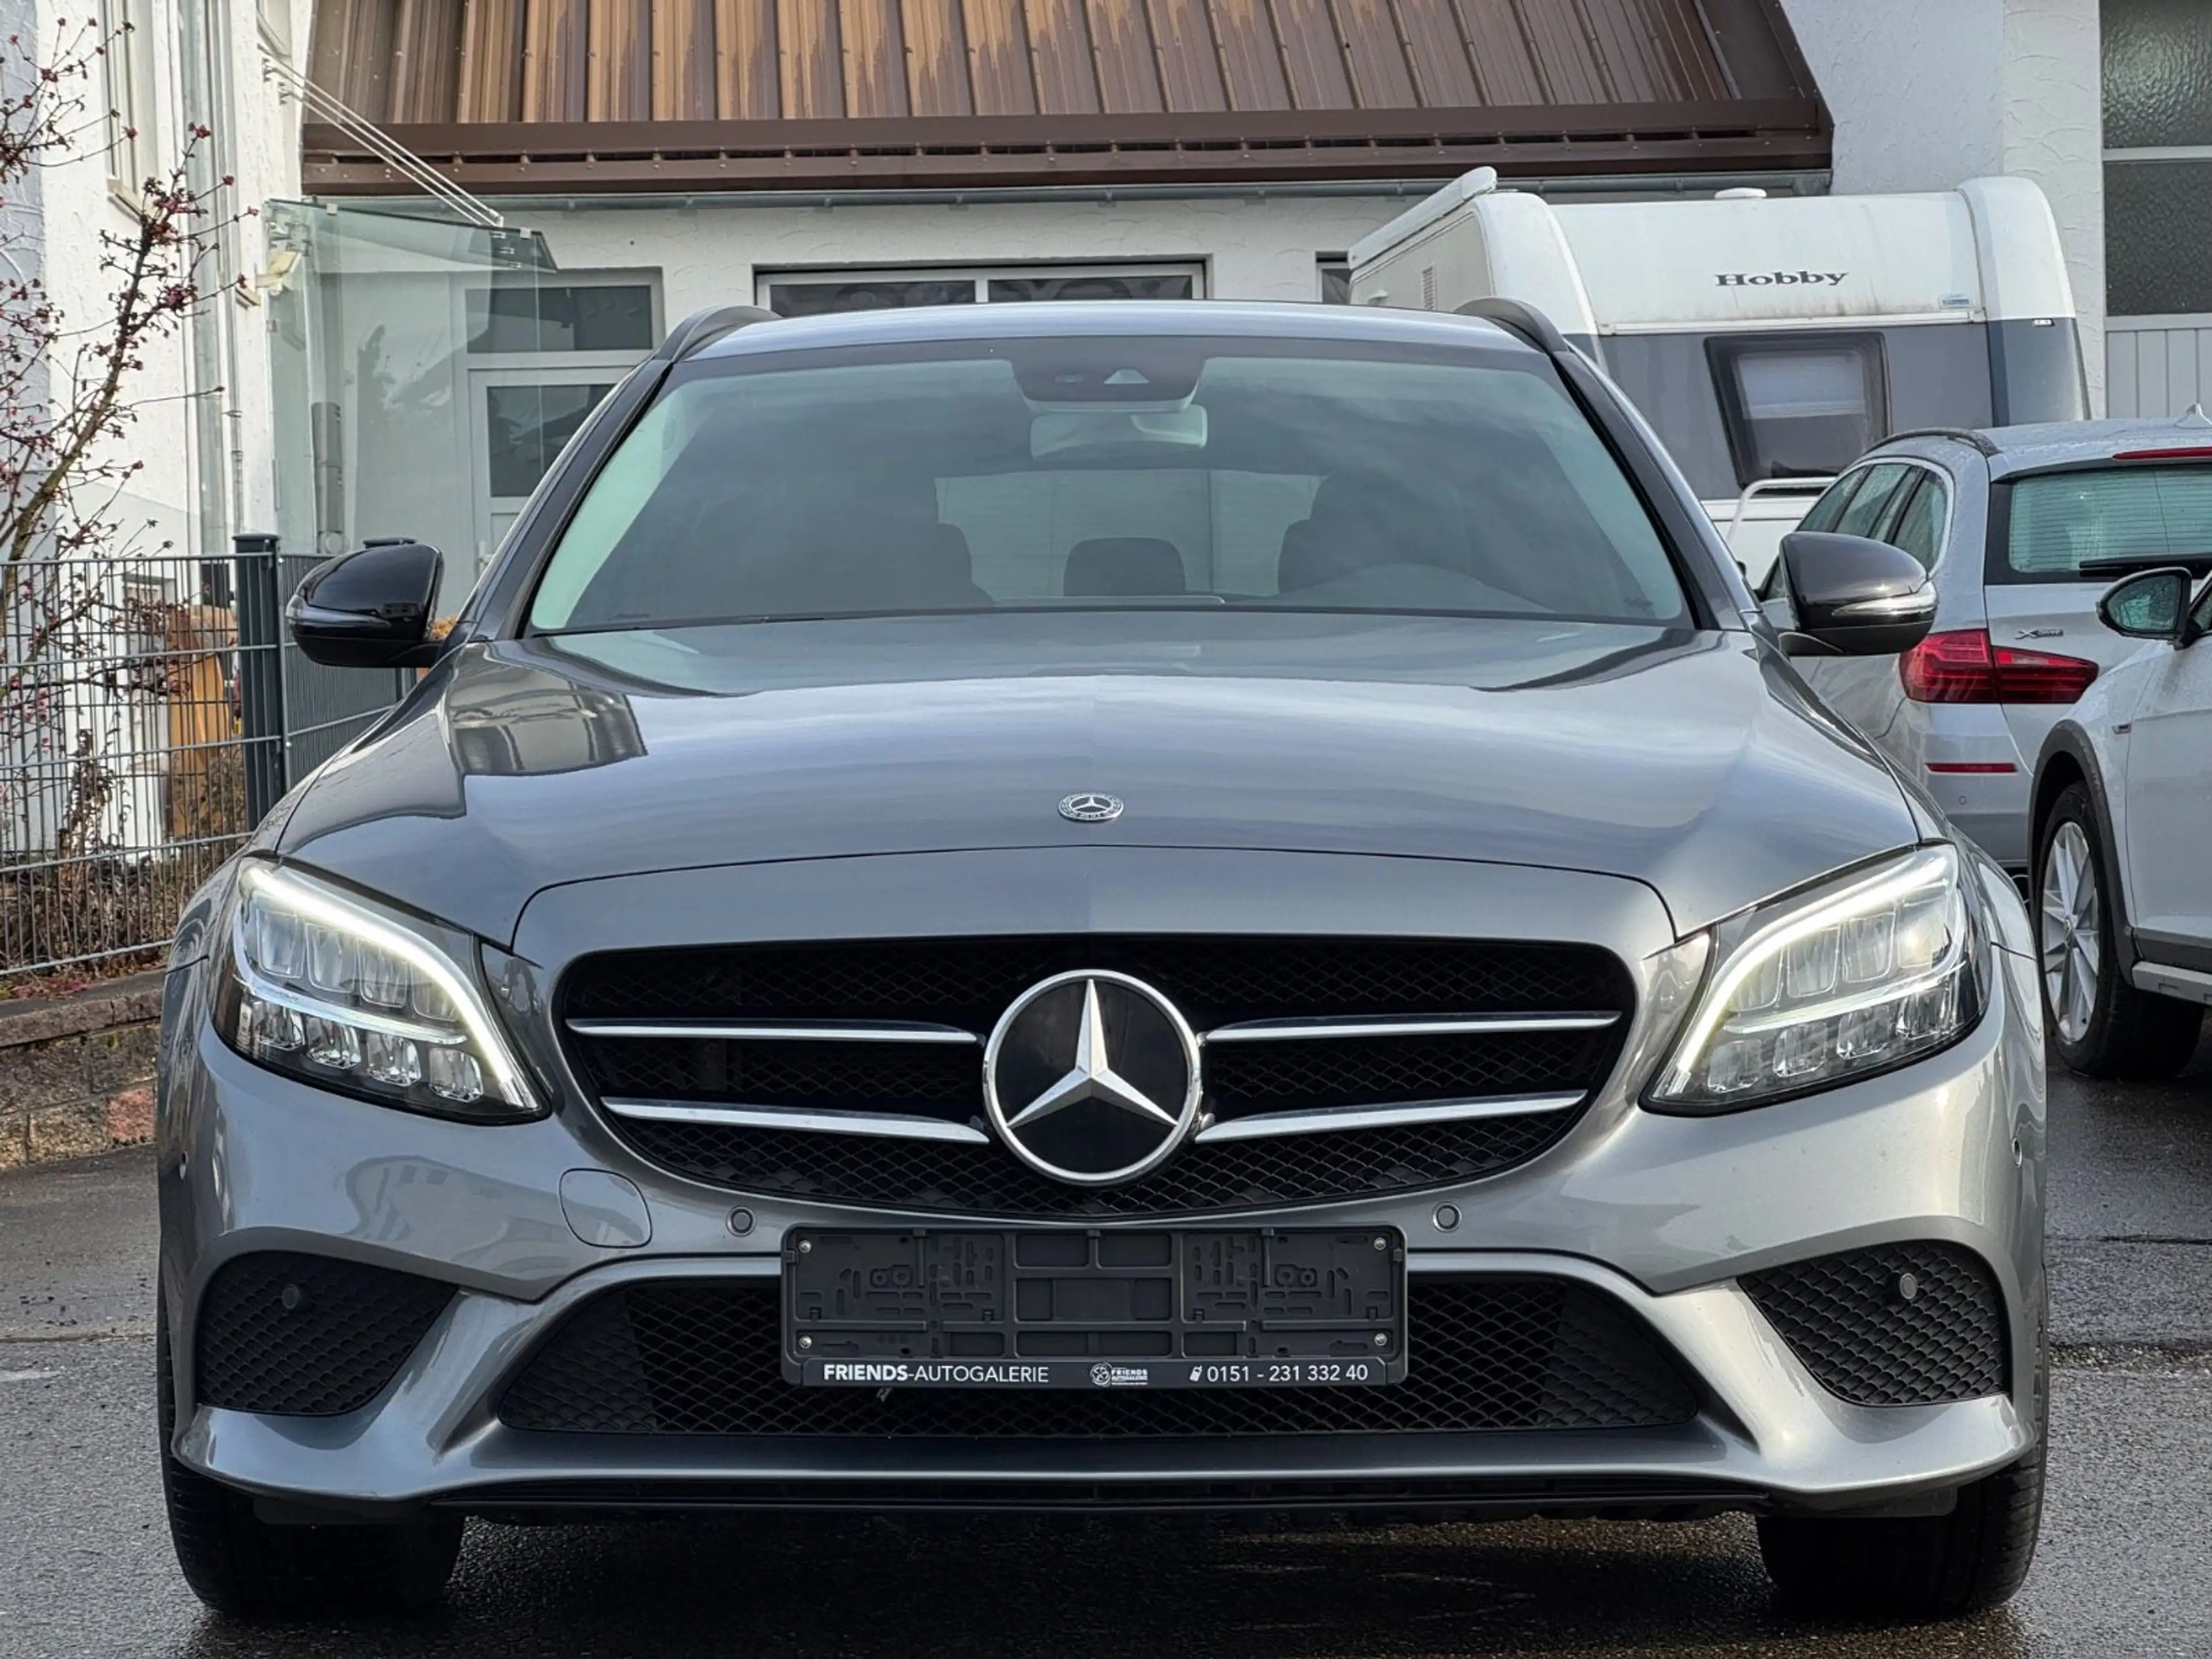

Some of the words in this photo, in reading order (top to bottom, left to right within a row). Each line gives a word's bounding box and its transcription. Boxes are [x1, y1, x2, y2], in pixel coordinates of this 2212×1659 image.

[1714, 270, 1849, 286] Hobby
[823, 1363, 1050, 1383] FRIENDS-AUTOGALERIE
[1207, 1365, 1249, 1382] 0151
[1269, 1365, 1300, 1382] 231
[1307, 1364, 1341, 1381] 332
[1345, 1364, 1369, 1381] 40
